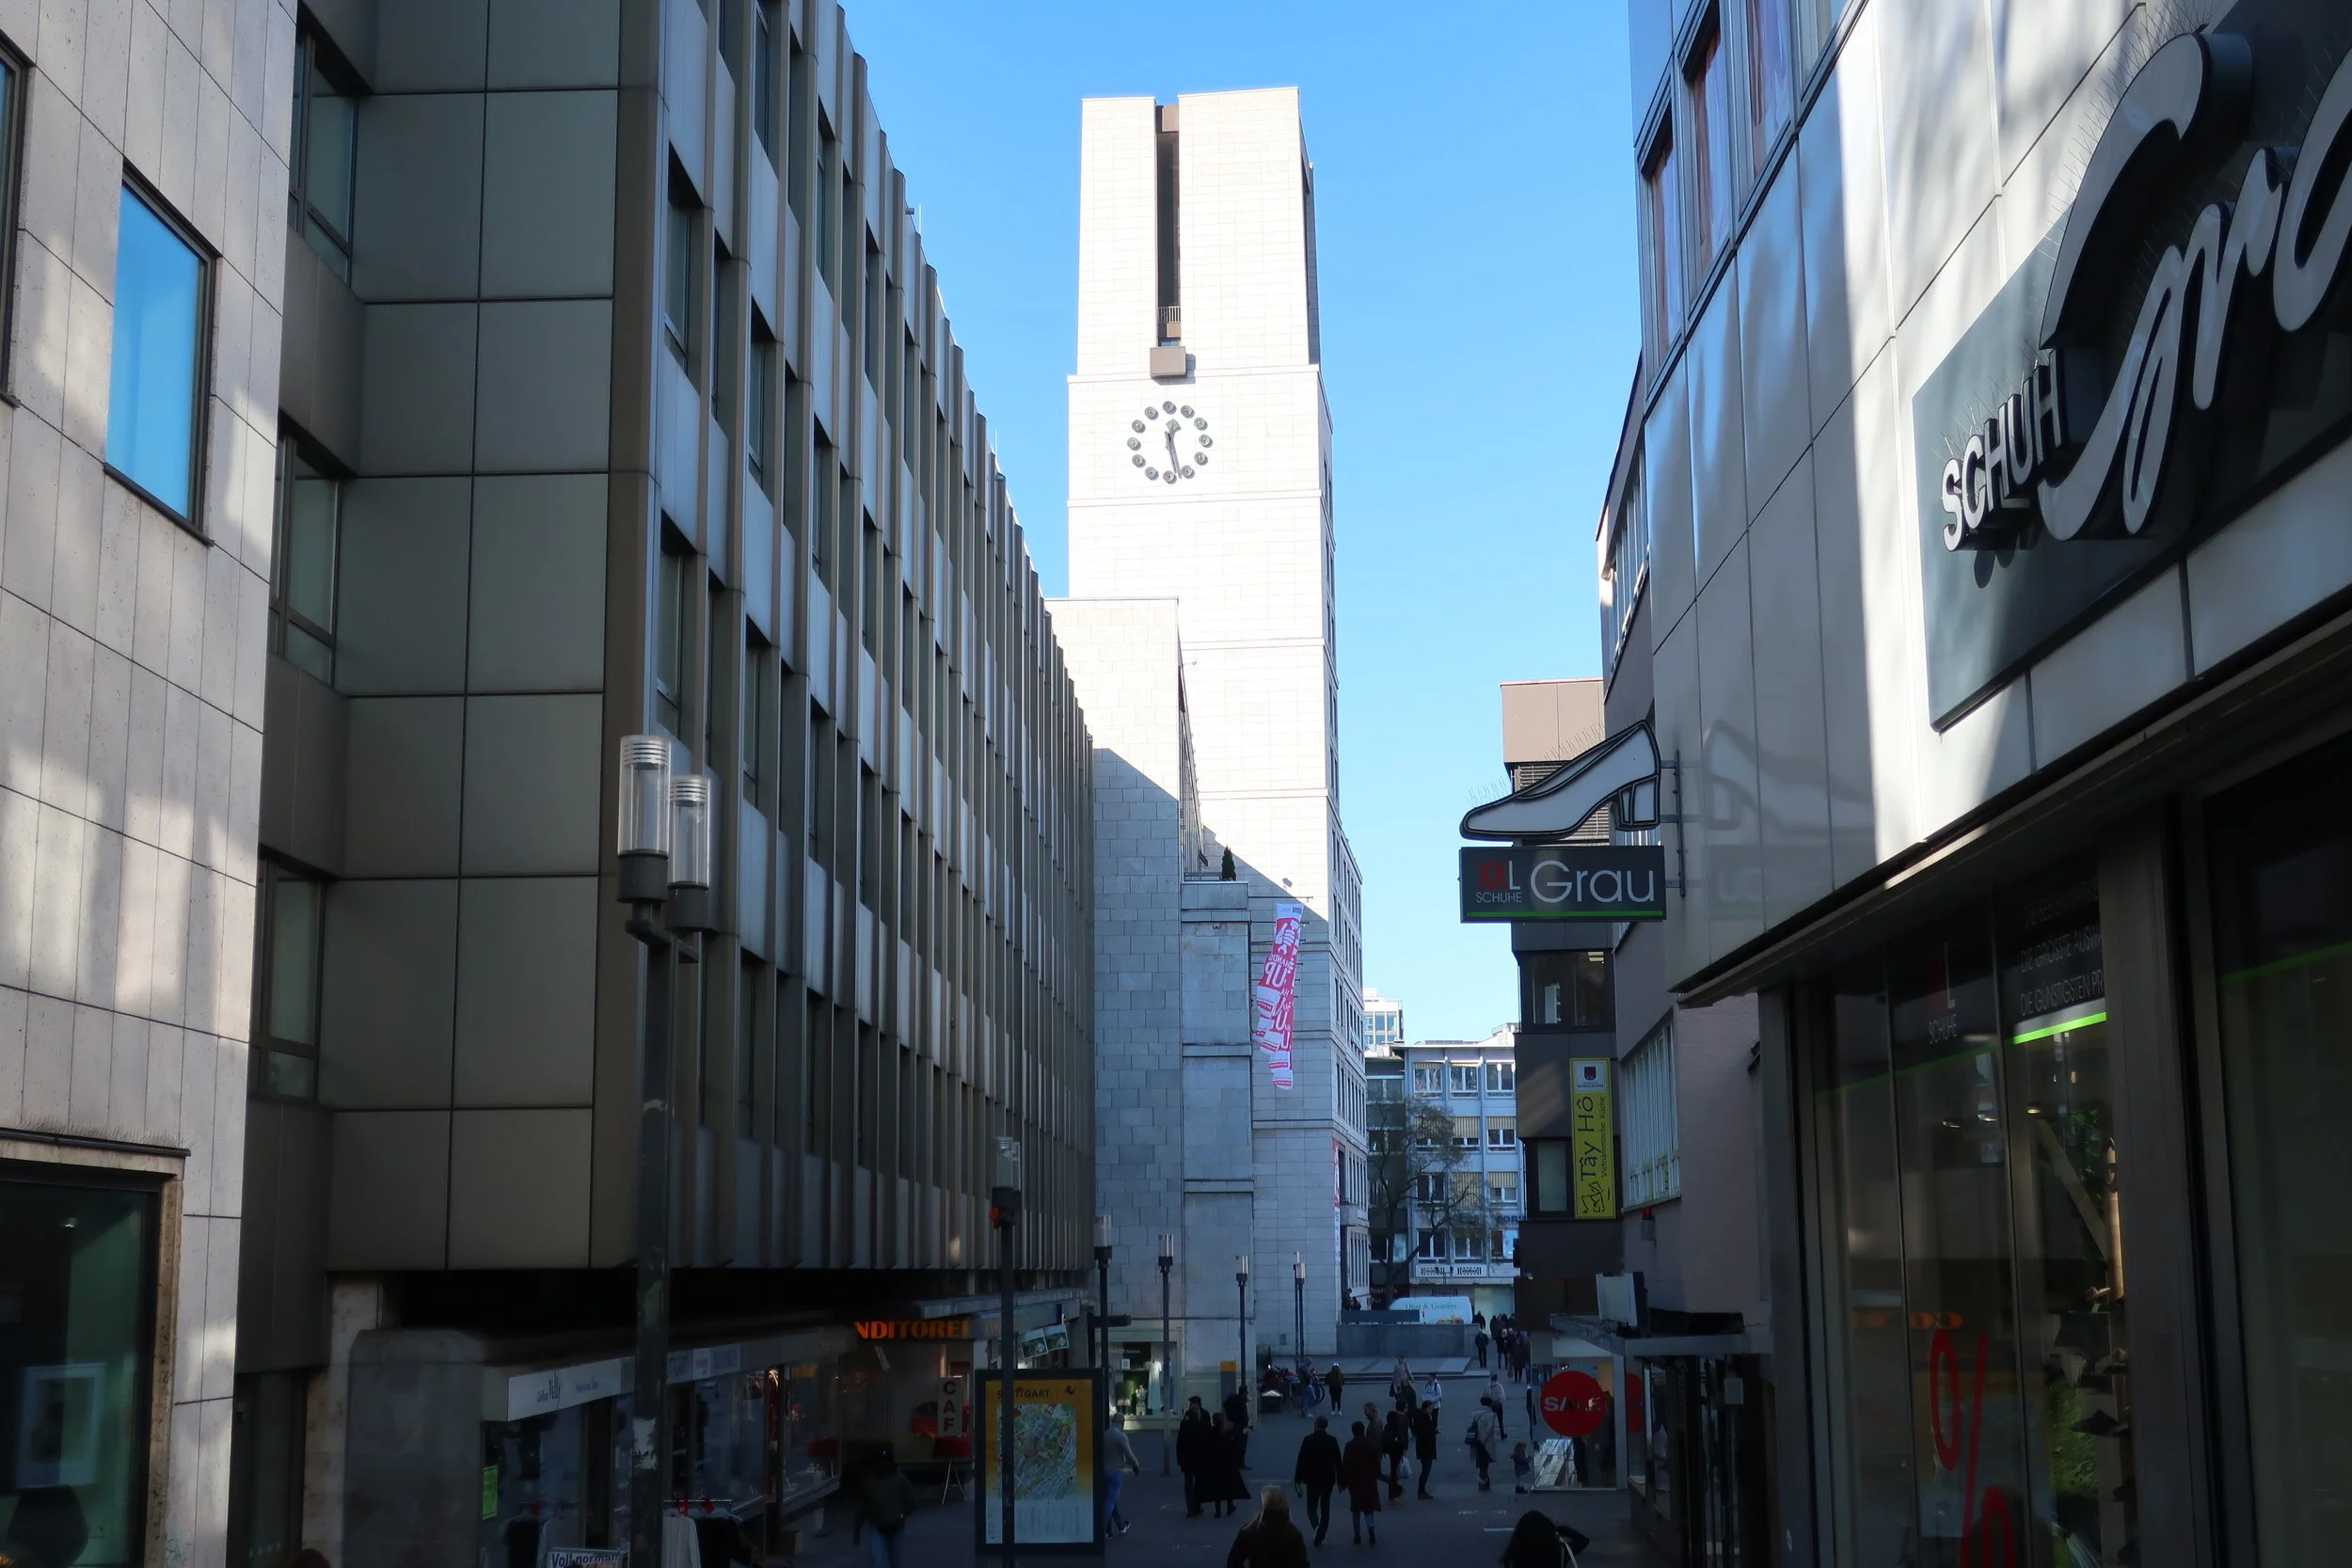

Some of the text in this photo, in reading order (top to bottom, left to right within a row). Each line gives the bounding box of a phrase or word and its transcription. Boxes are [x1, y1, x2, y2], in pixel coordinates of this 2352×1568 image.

[1941, 349, 2068, 552] SCHUH
[1476, 860, 1655, 904] XXL Grau
[1475, 892, 1522, 904] SCHUHE
[2020, 950, 2033, 973] DIE
[2020, 991, 2034, 1017] DIE
[1579, 1140, 1601, 1181] Tây
[551, 1553, 572, 1567] Voll
